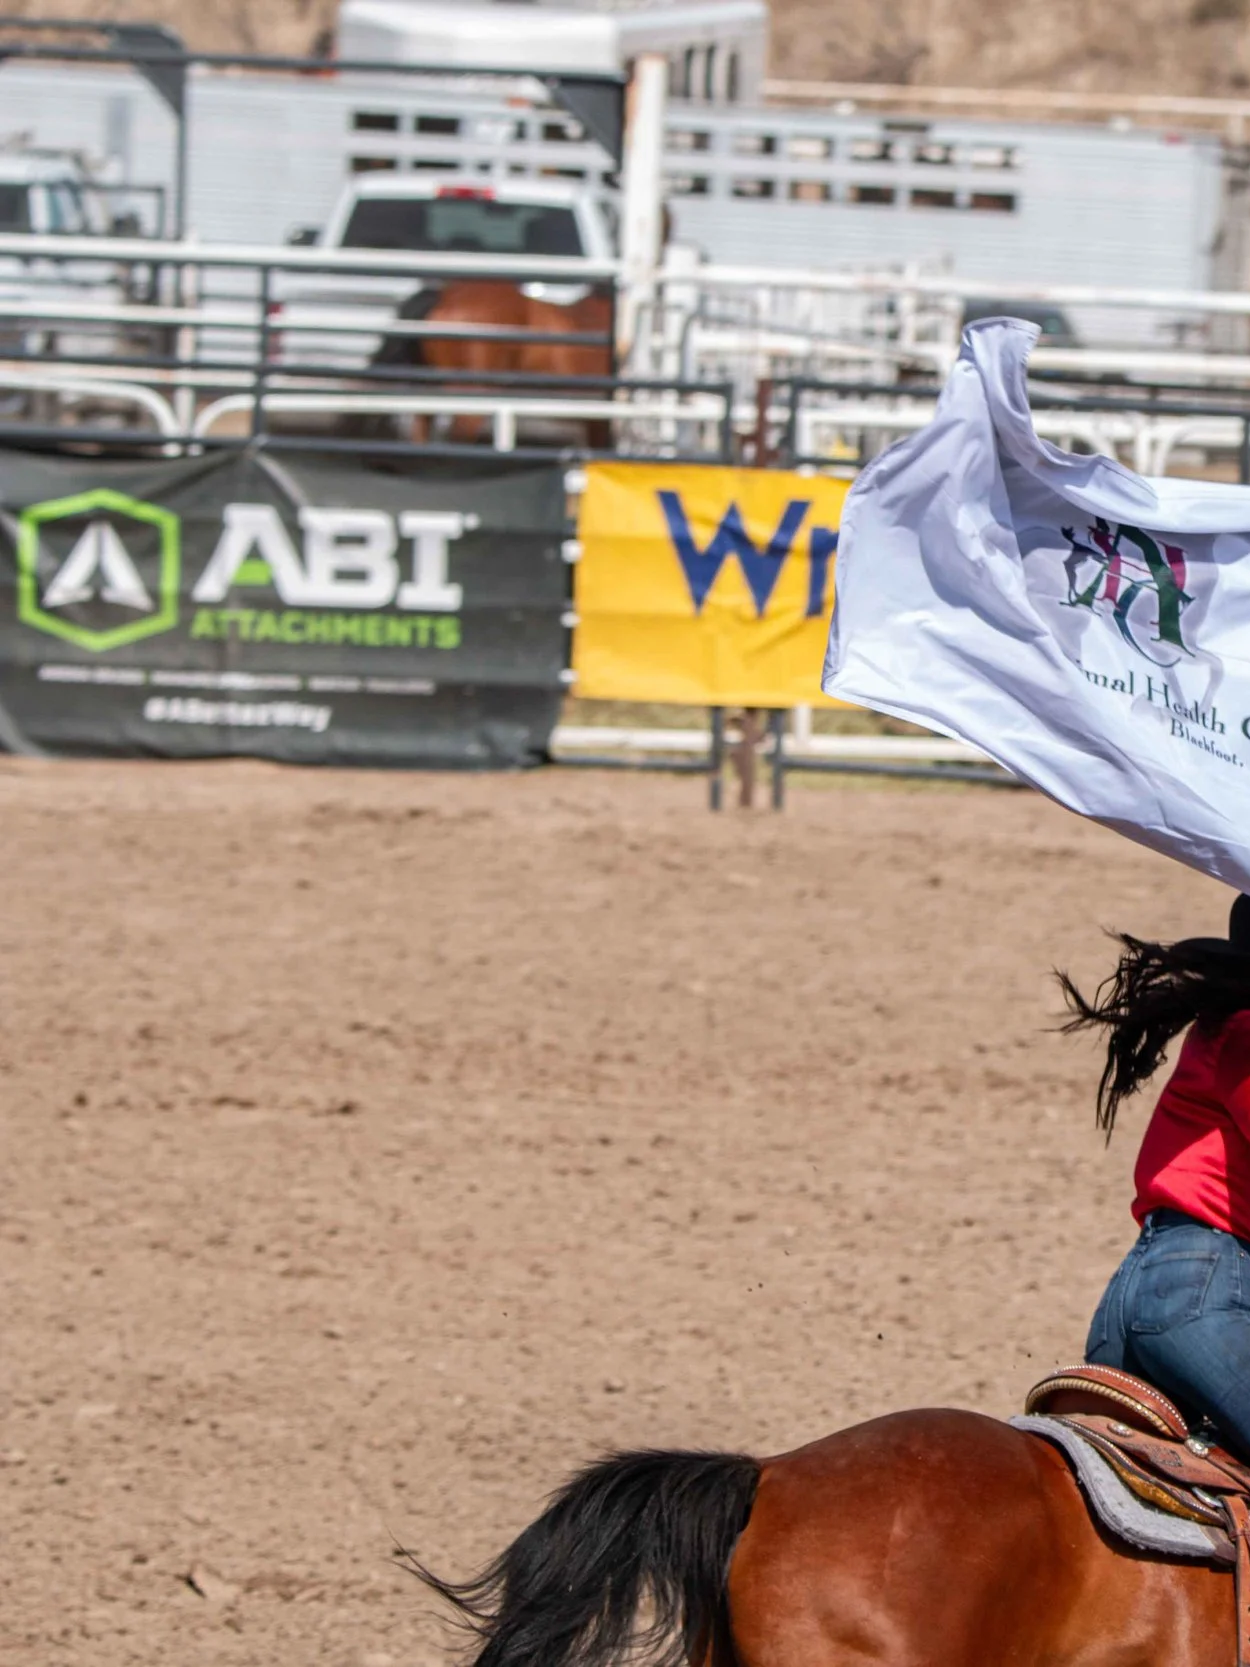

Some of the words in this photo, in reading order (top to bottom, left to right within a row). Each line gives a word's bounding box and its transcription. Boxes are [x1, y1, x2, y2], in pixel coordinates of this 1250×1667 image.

[192, 503, 463, 611] ABI
[190, 611, 461, 649] ATTACHMENTS
[1075, 658, 1135, 696] mal
[1146, 674, 1226, 736] Health
[1169, 717, 1245, 768] Blackfoot,
